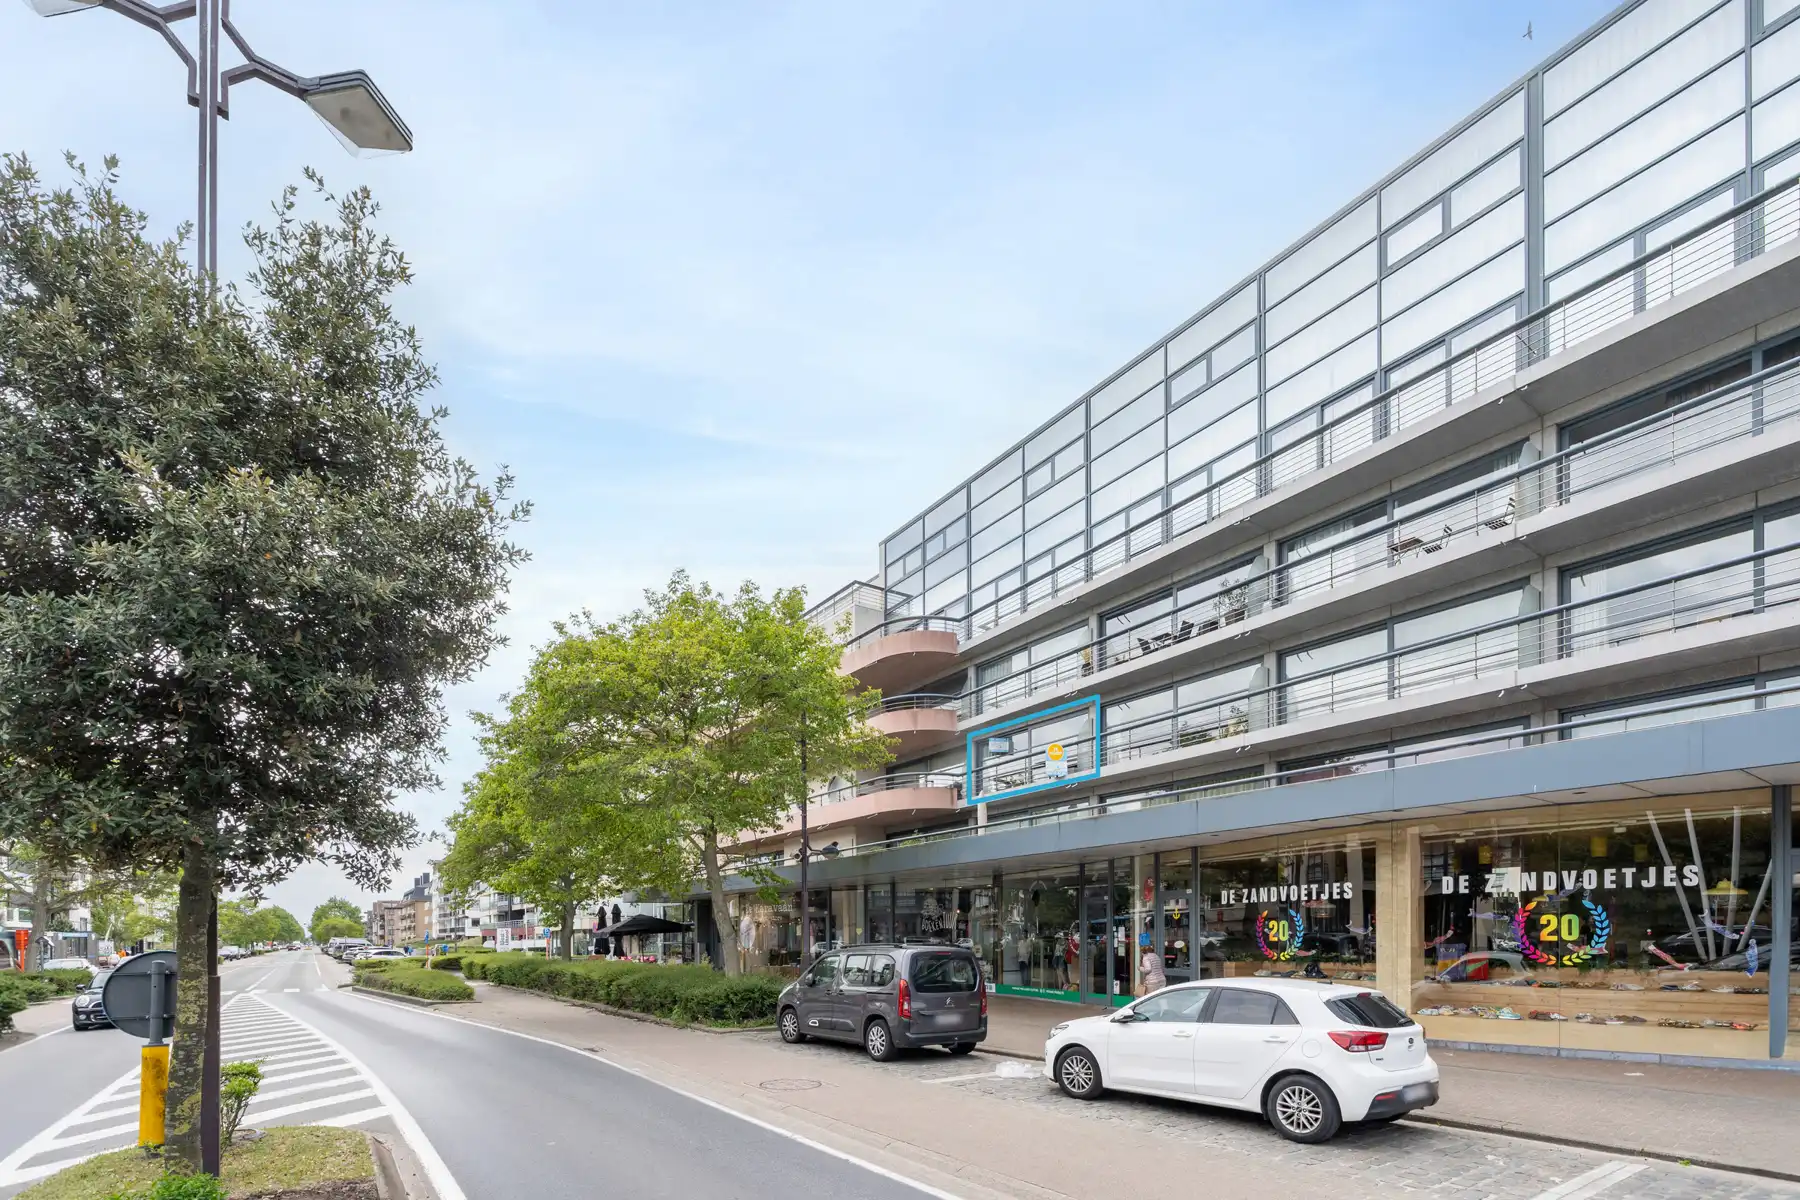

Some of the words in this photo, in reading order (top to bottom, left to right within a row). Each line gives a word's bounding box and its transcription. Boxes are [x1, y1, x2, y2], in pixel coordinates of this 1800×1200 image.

[1442, 875, 1469, 894] DE
[1485, 865, 1699, 893] ZANDVOETJES
[1221, 890, 1236, 905] DE
[1242, 882, 1353, 904] ZANDVOETJES
[1268, 920, 1289, 942] 20
[1540, 914, 1580, 941] 20
